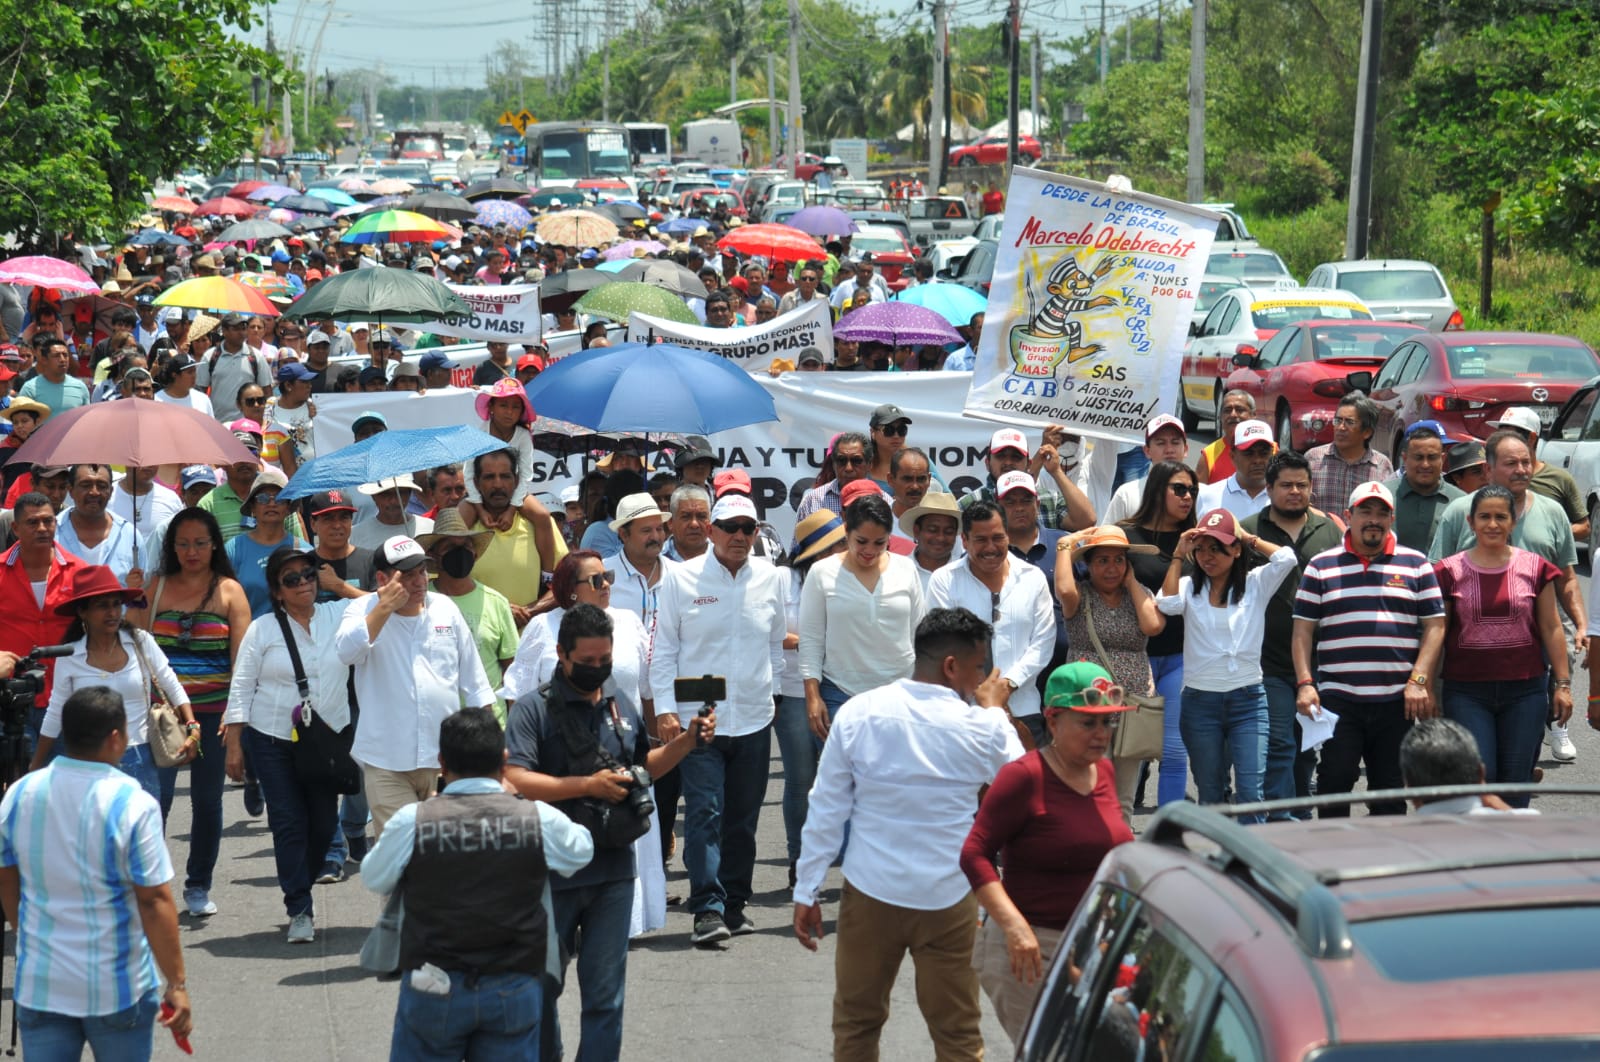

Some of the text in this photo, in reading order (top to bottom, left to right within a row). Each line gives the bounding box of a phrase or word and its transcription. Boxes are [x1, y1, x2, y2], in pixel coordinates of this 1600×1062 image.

[1041, 183, 1090, 203] DESDE
[1091, 196, 1112, 209] LA
[1104, 212, 1179, 237] DE BRASIL
[1014, 216, 1196, 257] Marcelo Odebrecht
[1119, 256, 1176, 273] SALUDA
[1152, 273, 1189, 286] YUNES
[482, 293, 519, 304] AGUA
[1151, 286, 1194, 299] POO GIL
[484, 318, 525, 335] MAS!
[754, 332, 769, 343] TU
[770, 319, 822, 339] ECONOMÍA
[773, 332, 816, 352] MAS!
[1027, 353, 1054, 363] Grupo
[1021, 365, 1049, 376] MAS
[1092, 364, 1127, 382] SAS
[1110, 385, 1134, 399] sin
[994, 399, 1081, 422] CORRUPCIÓN
[1075, 397, 1160, 420] JUSTICIA!
[418, 815, 540, 854] PRENSA
